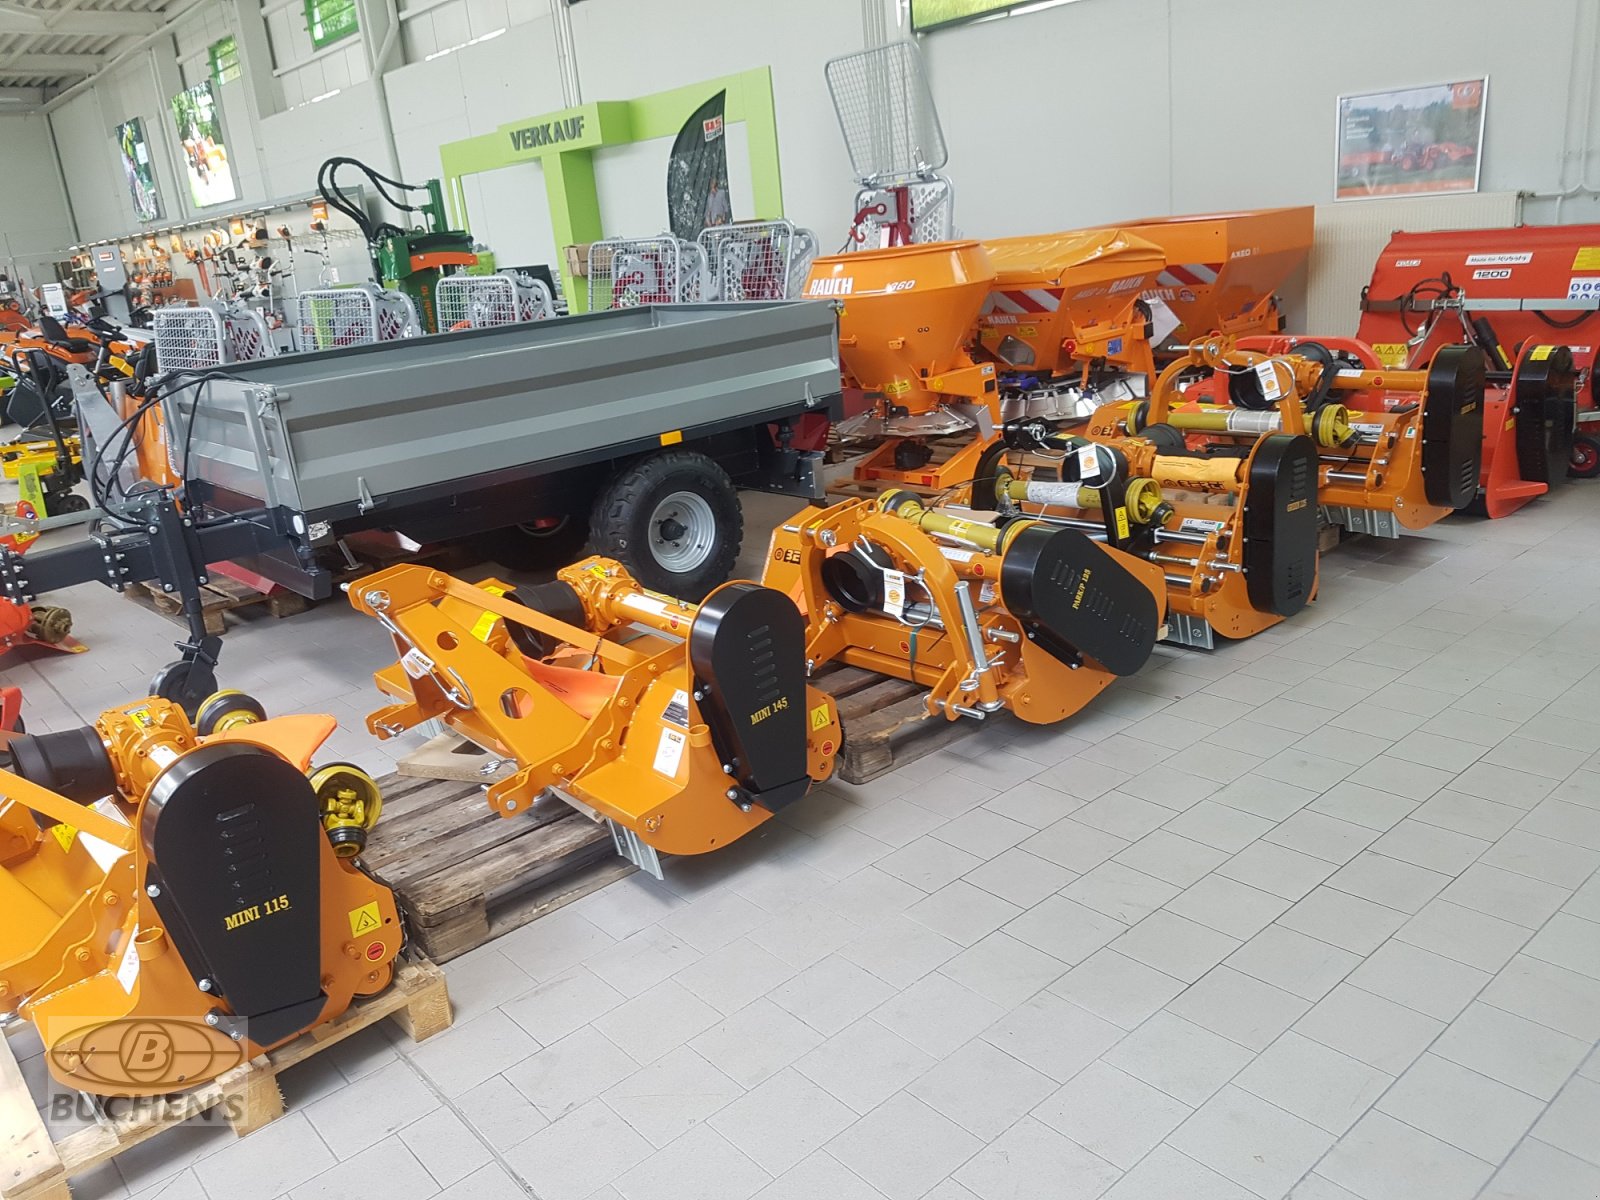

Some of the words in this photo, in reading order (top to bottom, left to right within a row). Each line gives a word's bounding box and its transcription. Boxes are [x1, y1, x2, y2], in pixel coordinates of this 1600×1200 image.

[509, 115, 585, 151] VERKAUF
[1476, 269, 1509, 278] 1200
[809, 277, 854, 296] RAUCH
[1141, 288, 1176, 301] AUCH
[750, 705, 772, 726] MINI
[772, 696, 788, 713] 145
[224, 905, 261, 931] MINI
[263, 894, 289, 915] 115
